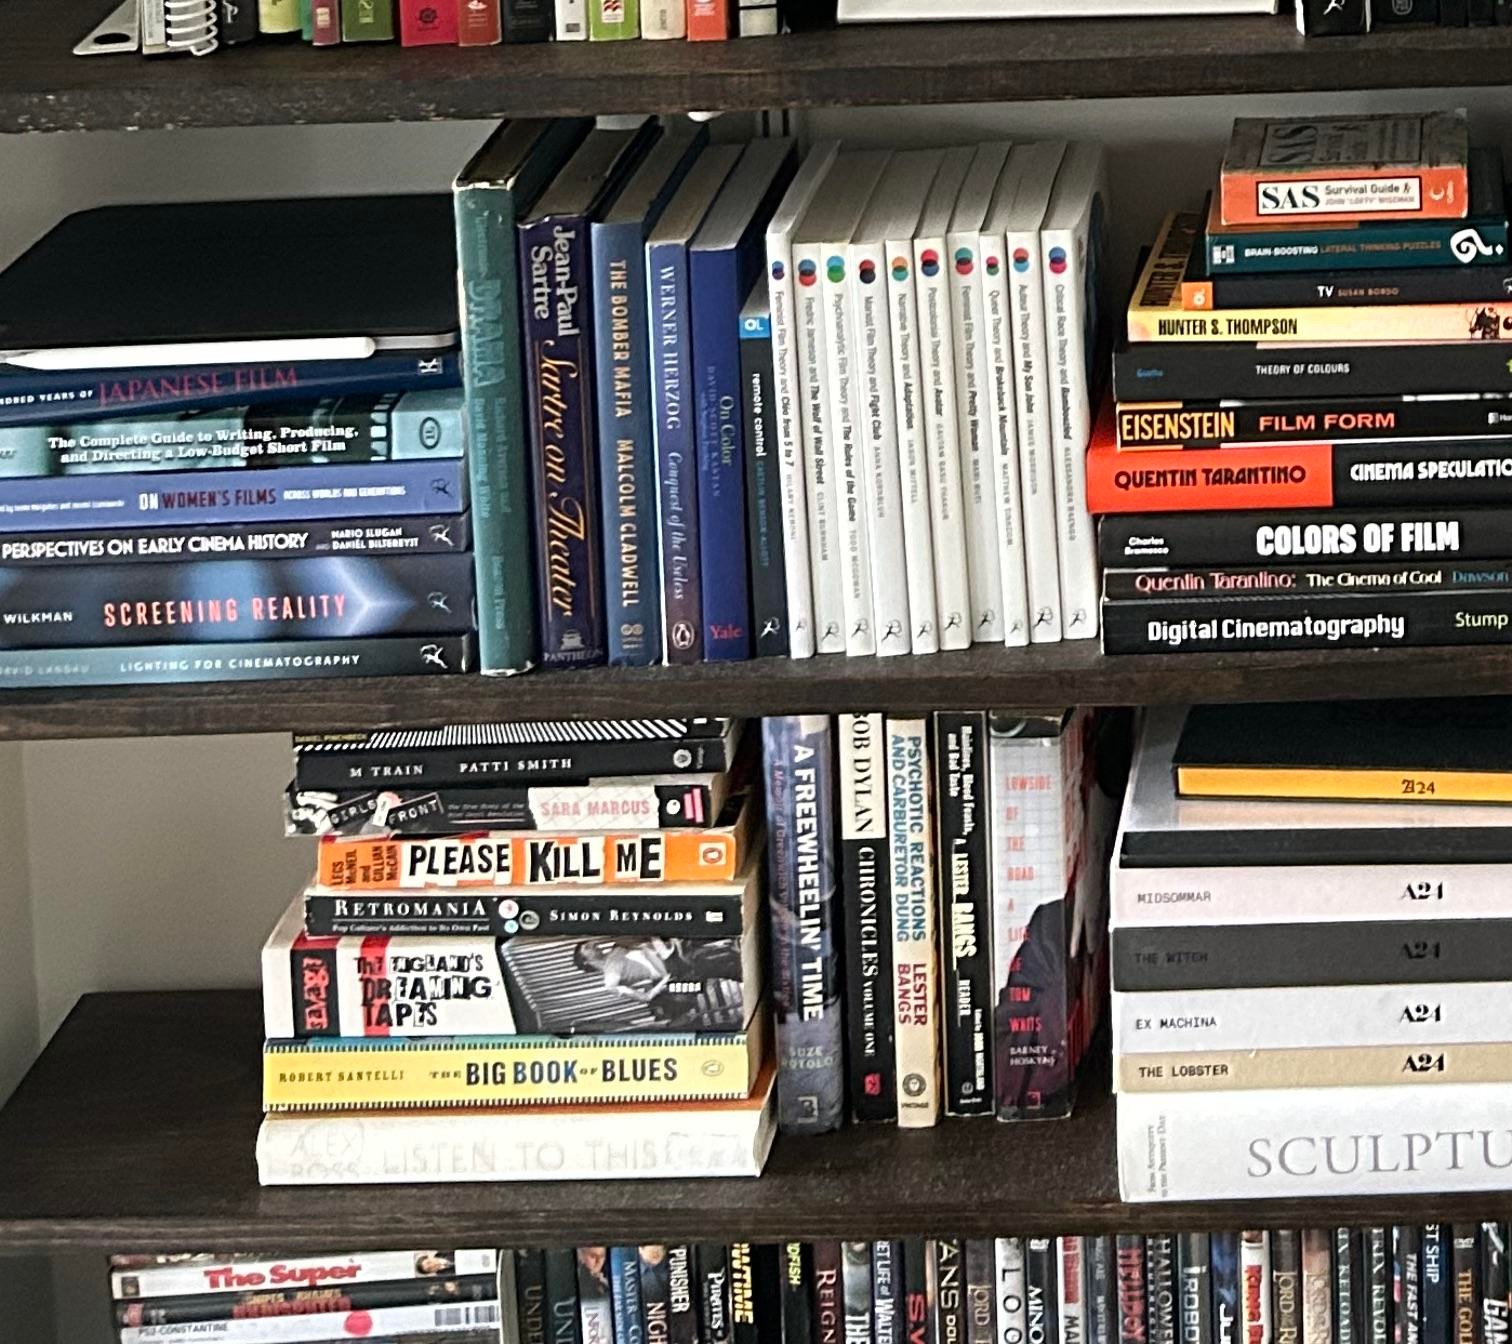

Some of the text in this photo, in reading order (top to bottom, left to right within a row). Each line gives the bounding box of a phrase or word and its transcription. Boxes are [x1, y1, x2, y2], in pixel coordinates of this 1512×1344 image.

[1262, 186, 1320, 208] SAS
[531, 246, 550, 319] Sartre
[552, 225, 580, 338] Jean-Paul
[1158, 318, 1297, 336] HUNTER S. THOMPSON
[1122, 412, 1395, 440] EISENSTEIN FILM FORM
[1257, 522, 1459, 555] COLORS OF FILM
[104, 595, 345, 628] SCREENING REALITY
[1148, 611, 1509, 641] Digital Cinematography Stump
[408, 838, 661, 880] PLEASE KILL ME
[1135, 1017, 1152, 1029] EX
[1160, 1016, 1217, 1029] MACHINA
[465, 1058, 678, 1086] BIG BOOK BLUES
[1139, 1066, 1164, 1078] THE
[1171, 1064, 1228, 1077] LOBSTER
[203, 1260, 361, 1289] The Super
